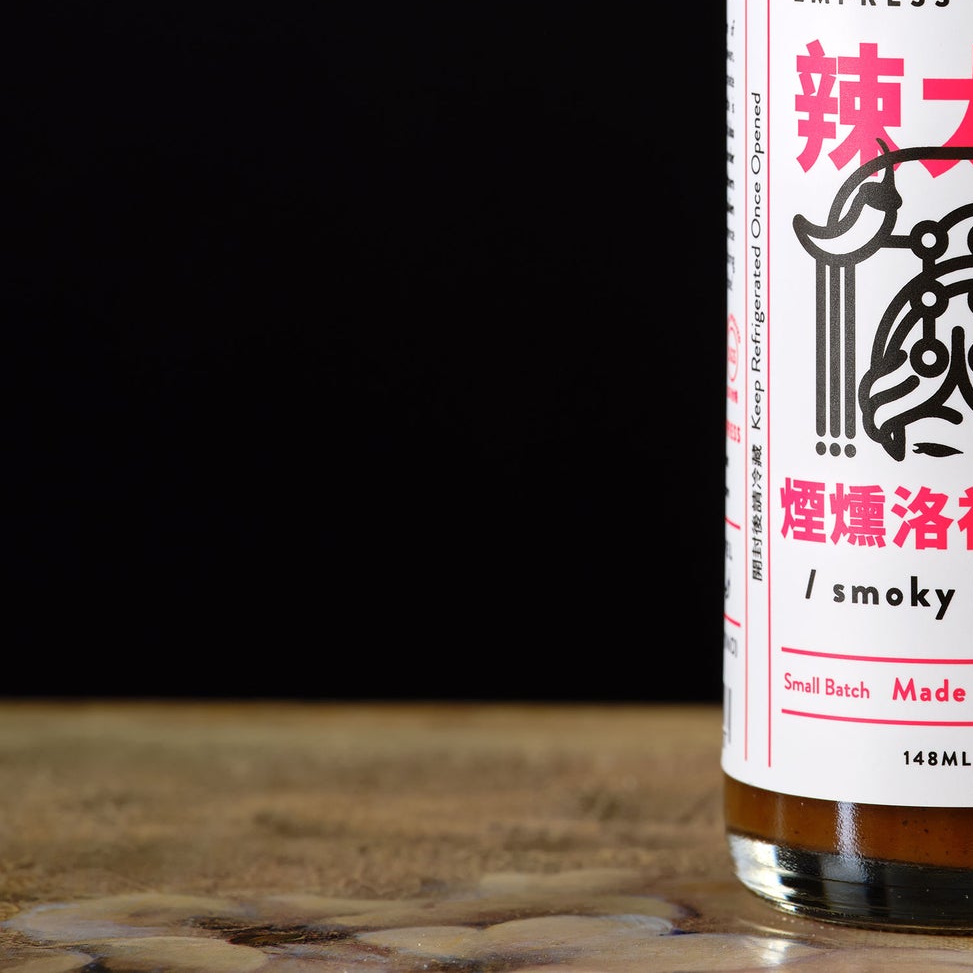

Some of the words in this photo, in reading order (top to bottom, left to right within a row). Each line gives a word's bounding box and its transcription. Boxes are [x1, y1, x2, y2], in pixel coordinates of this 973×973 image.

[751, 92, 765, 175] Opened
[751, 181, 762, 239] Once
[751, 246, 765, 373] Refrigerated
[751, 380, 765, 430] Keep
[751, 444, 763, 582] 開封後請冷藏
[832, 575, 956, 621] smoky
[784, 673, 820, 695] Small
[825, 678, 870, 699] Batch
[892, 677, 967, 702] Made
[903, 750, 972, 767] 148ML
